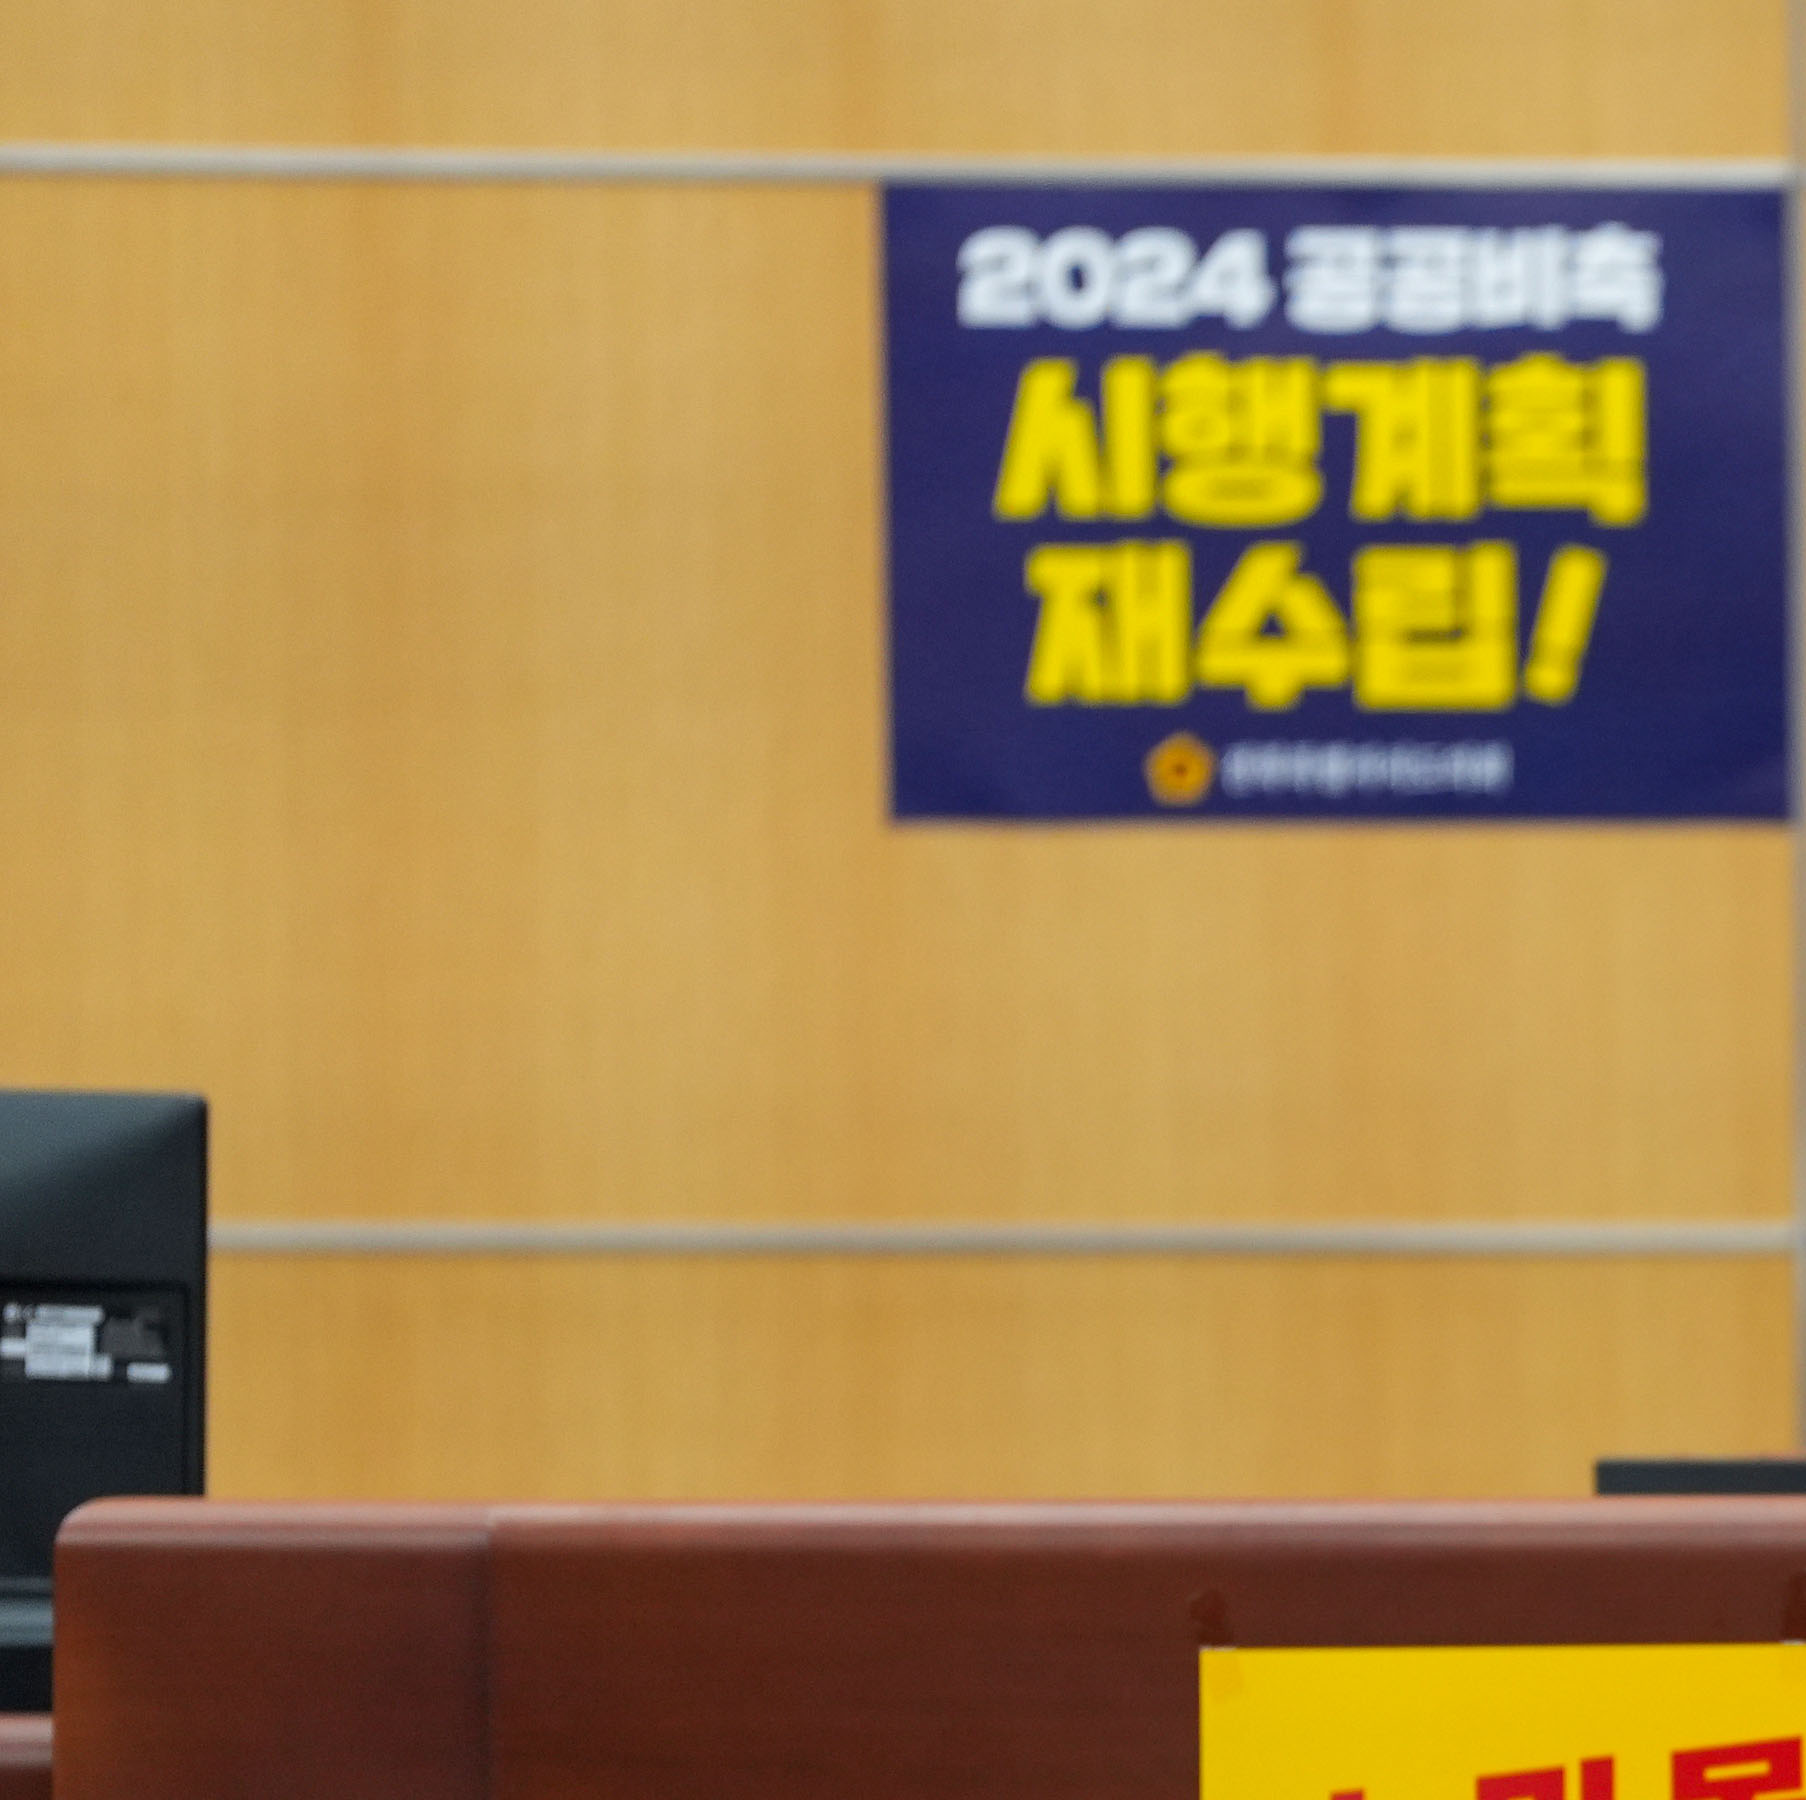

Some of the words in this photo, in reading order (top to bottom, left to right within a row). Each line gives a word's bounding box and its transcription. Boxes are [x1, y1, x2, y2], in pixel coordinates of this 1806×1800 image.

[957, 227, 1276, 328] 2024
[996, 354, 1646, 526] 시행계획
[1027, 543, 1606, 709] 재수립!
